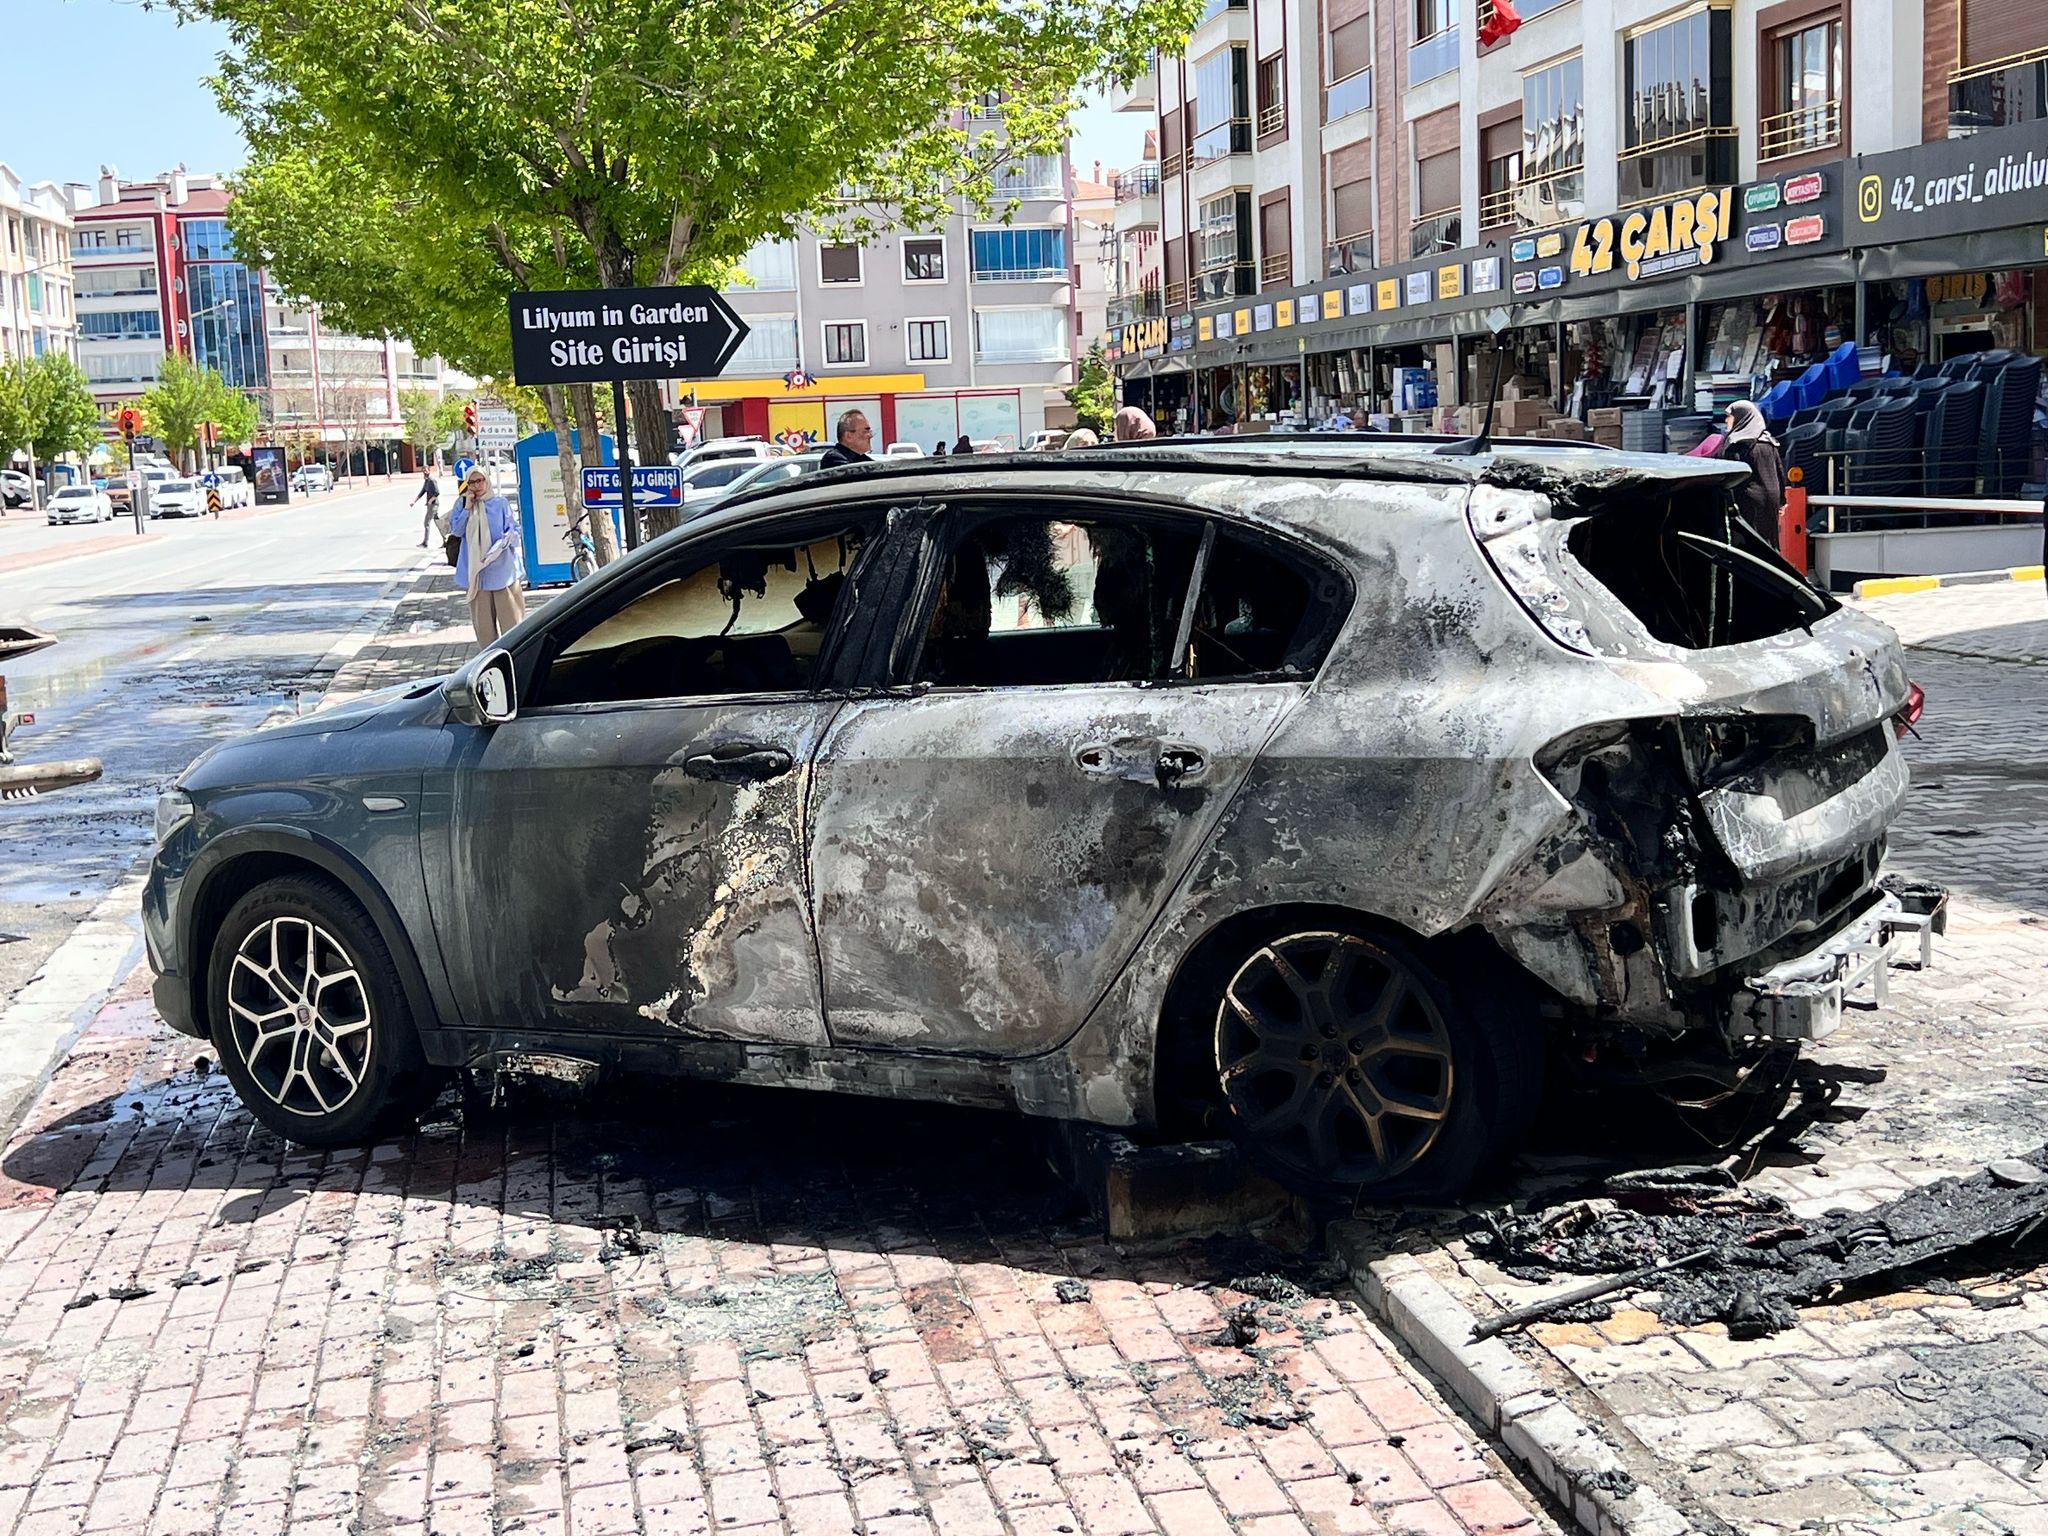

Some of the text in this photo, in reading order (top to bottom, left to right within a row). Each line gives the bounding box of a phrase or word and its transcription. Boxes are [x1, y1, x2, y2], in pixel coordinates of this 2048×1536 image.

[1569, 186, 1733, 281] 42 ÇARŞI
[522, 302, 709, 333] Lilyum in Garden
[550, 335, 688, 369] Site Girişi
[1122, 323, 1136, 354] 42
[480, 426, 514, 434] Adana
[587, 470, 610, 488] SİTE
[647, 470, 678, 490] GİRİŞİ
